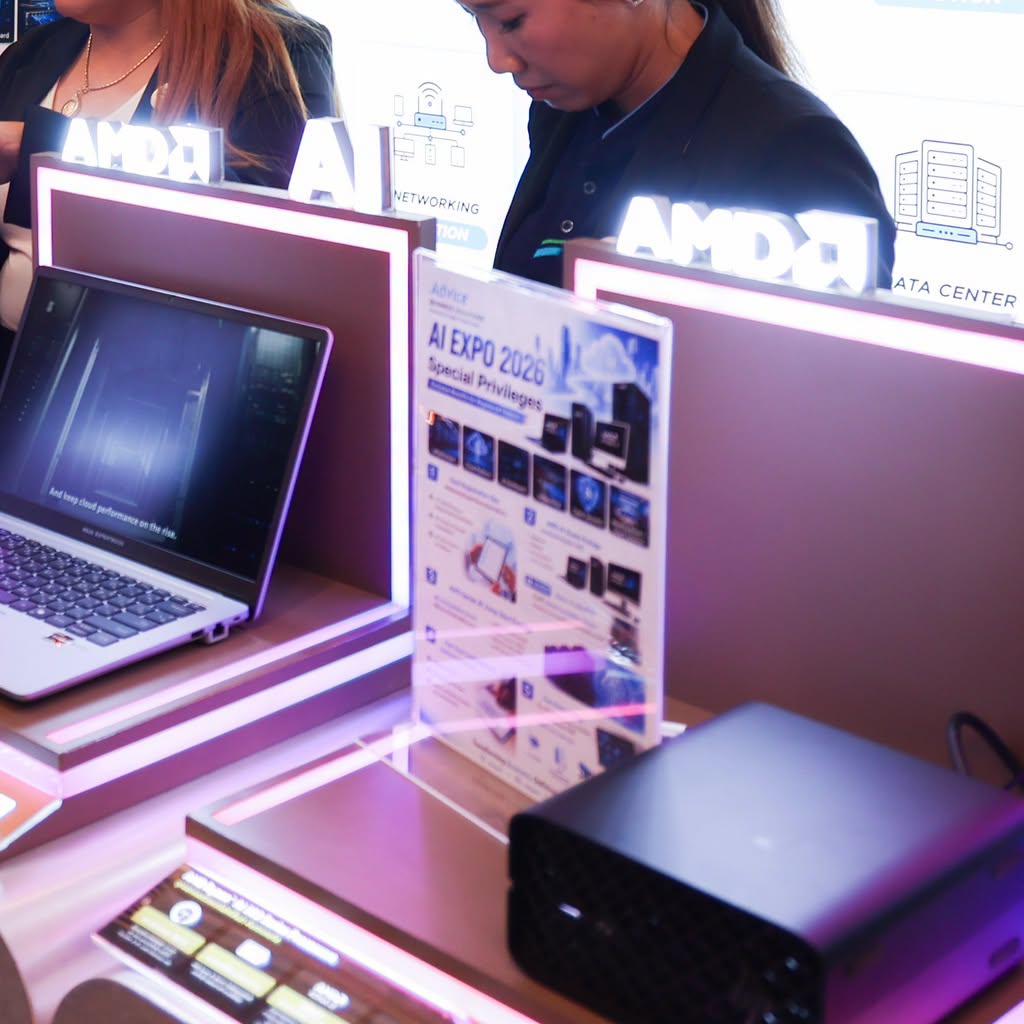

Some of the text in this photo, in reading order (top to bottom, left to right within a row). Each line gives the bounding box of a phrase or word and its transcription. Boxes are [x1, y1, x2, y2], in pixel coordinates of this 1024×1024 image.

[288, 116, 389, 213] AI
[394, 189, 480, 215] NETWORKING
[437, 223, 470, 241] TION
[894, 277, 1017, 308] ATA CENTER
[429, 322, 545, 386] AI EXPO 2026
[428, 356, 474, 386] Special
[478, 375, 543, 411] Privileges
[49, 487, 177, 540] And keep cloud performance on the rise.
